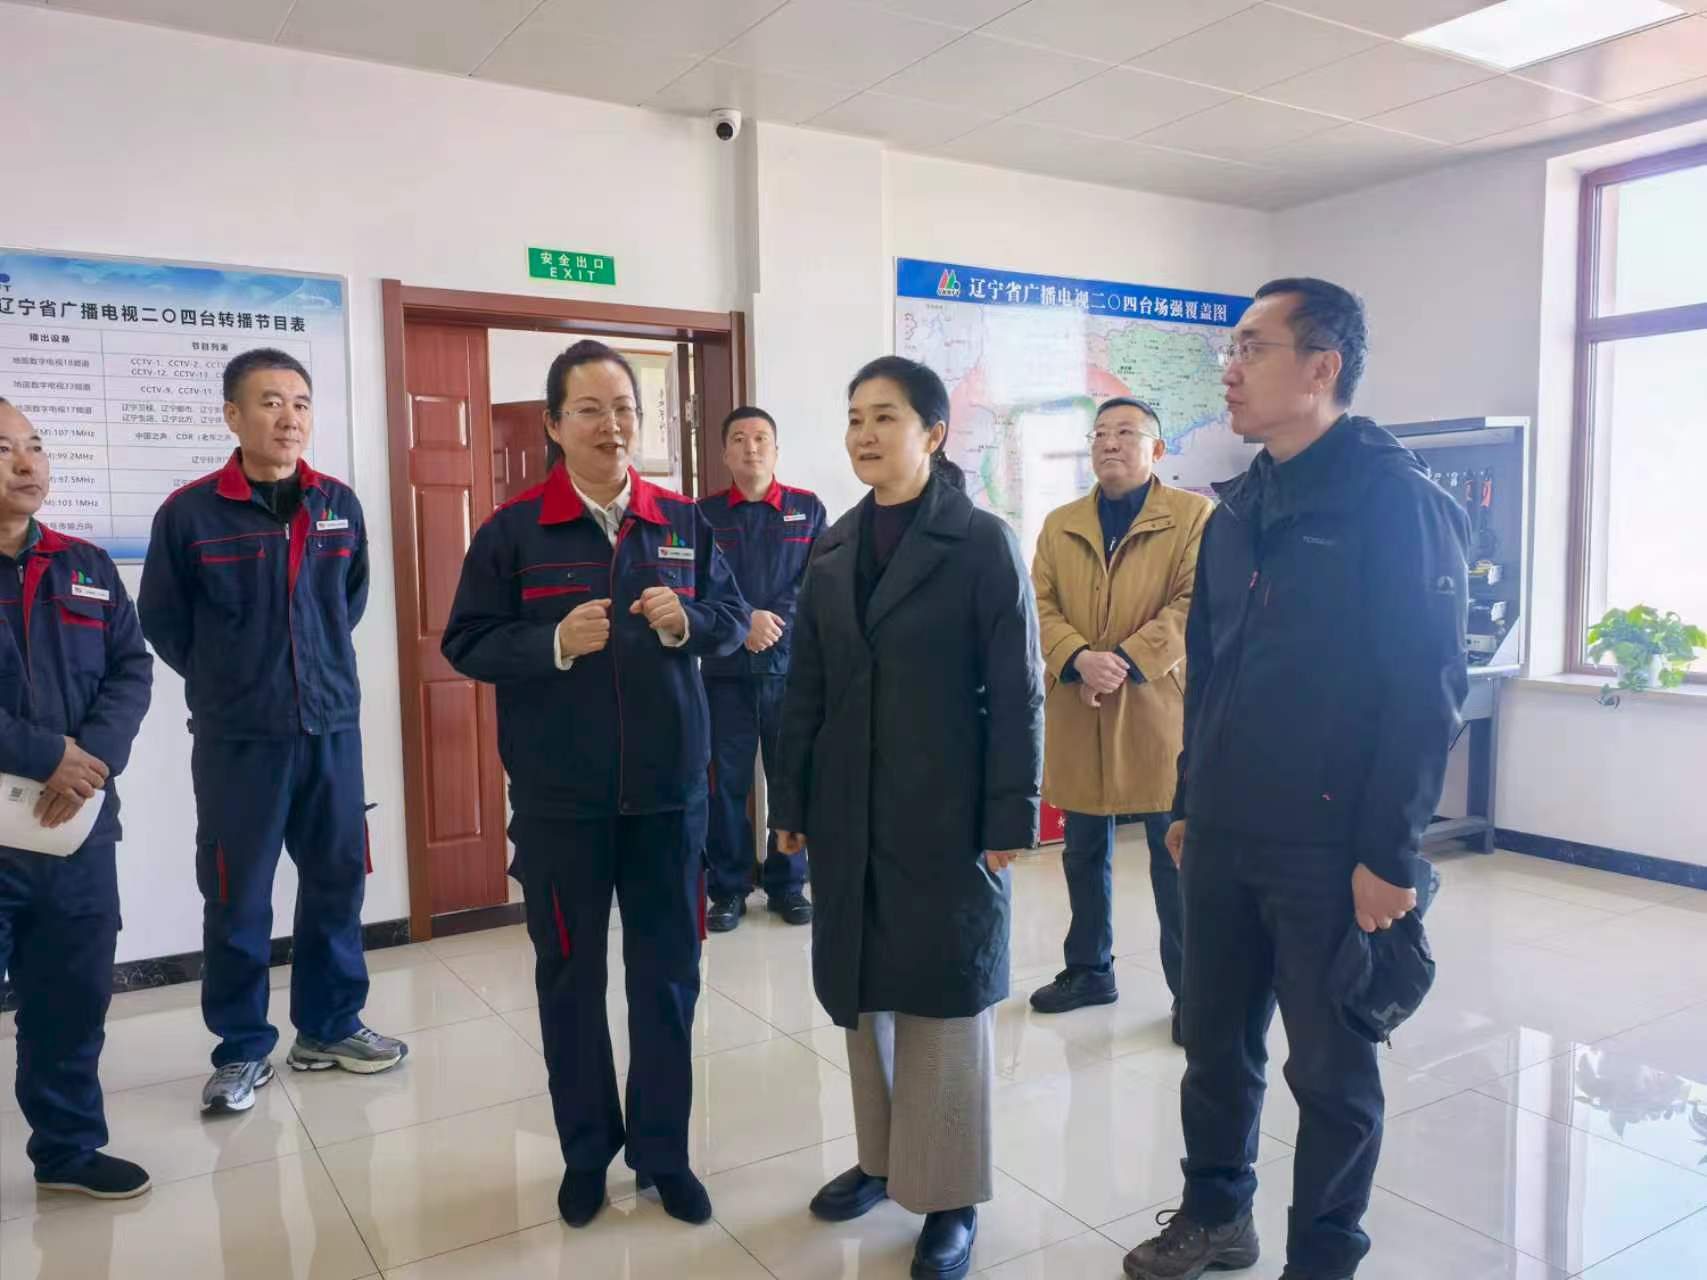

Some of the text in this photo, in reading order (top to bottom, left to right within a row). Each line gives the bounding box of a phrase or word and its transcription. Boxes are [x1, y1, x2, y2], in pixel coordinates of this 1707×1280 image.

[540, 251, 604, 269] 安全出口
[550, 267, 595, 281] EXIT
